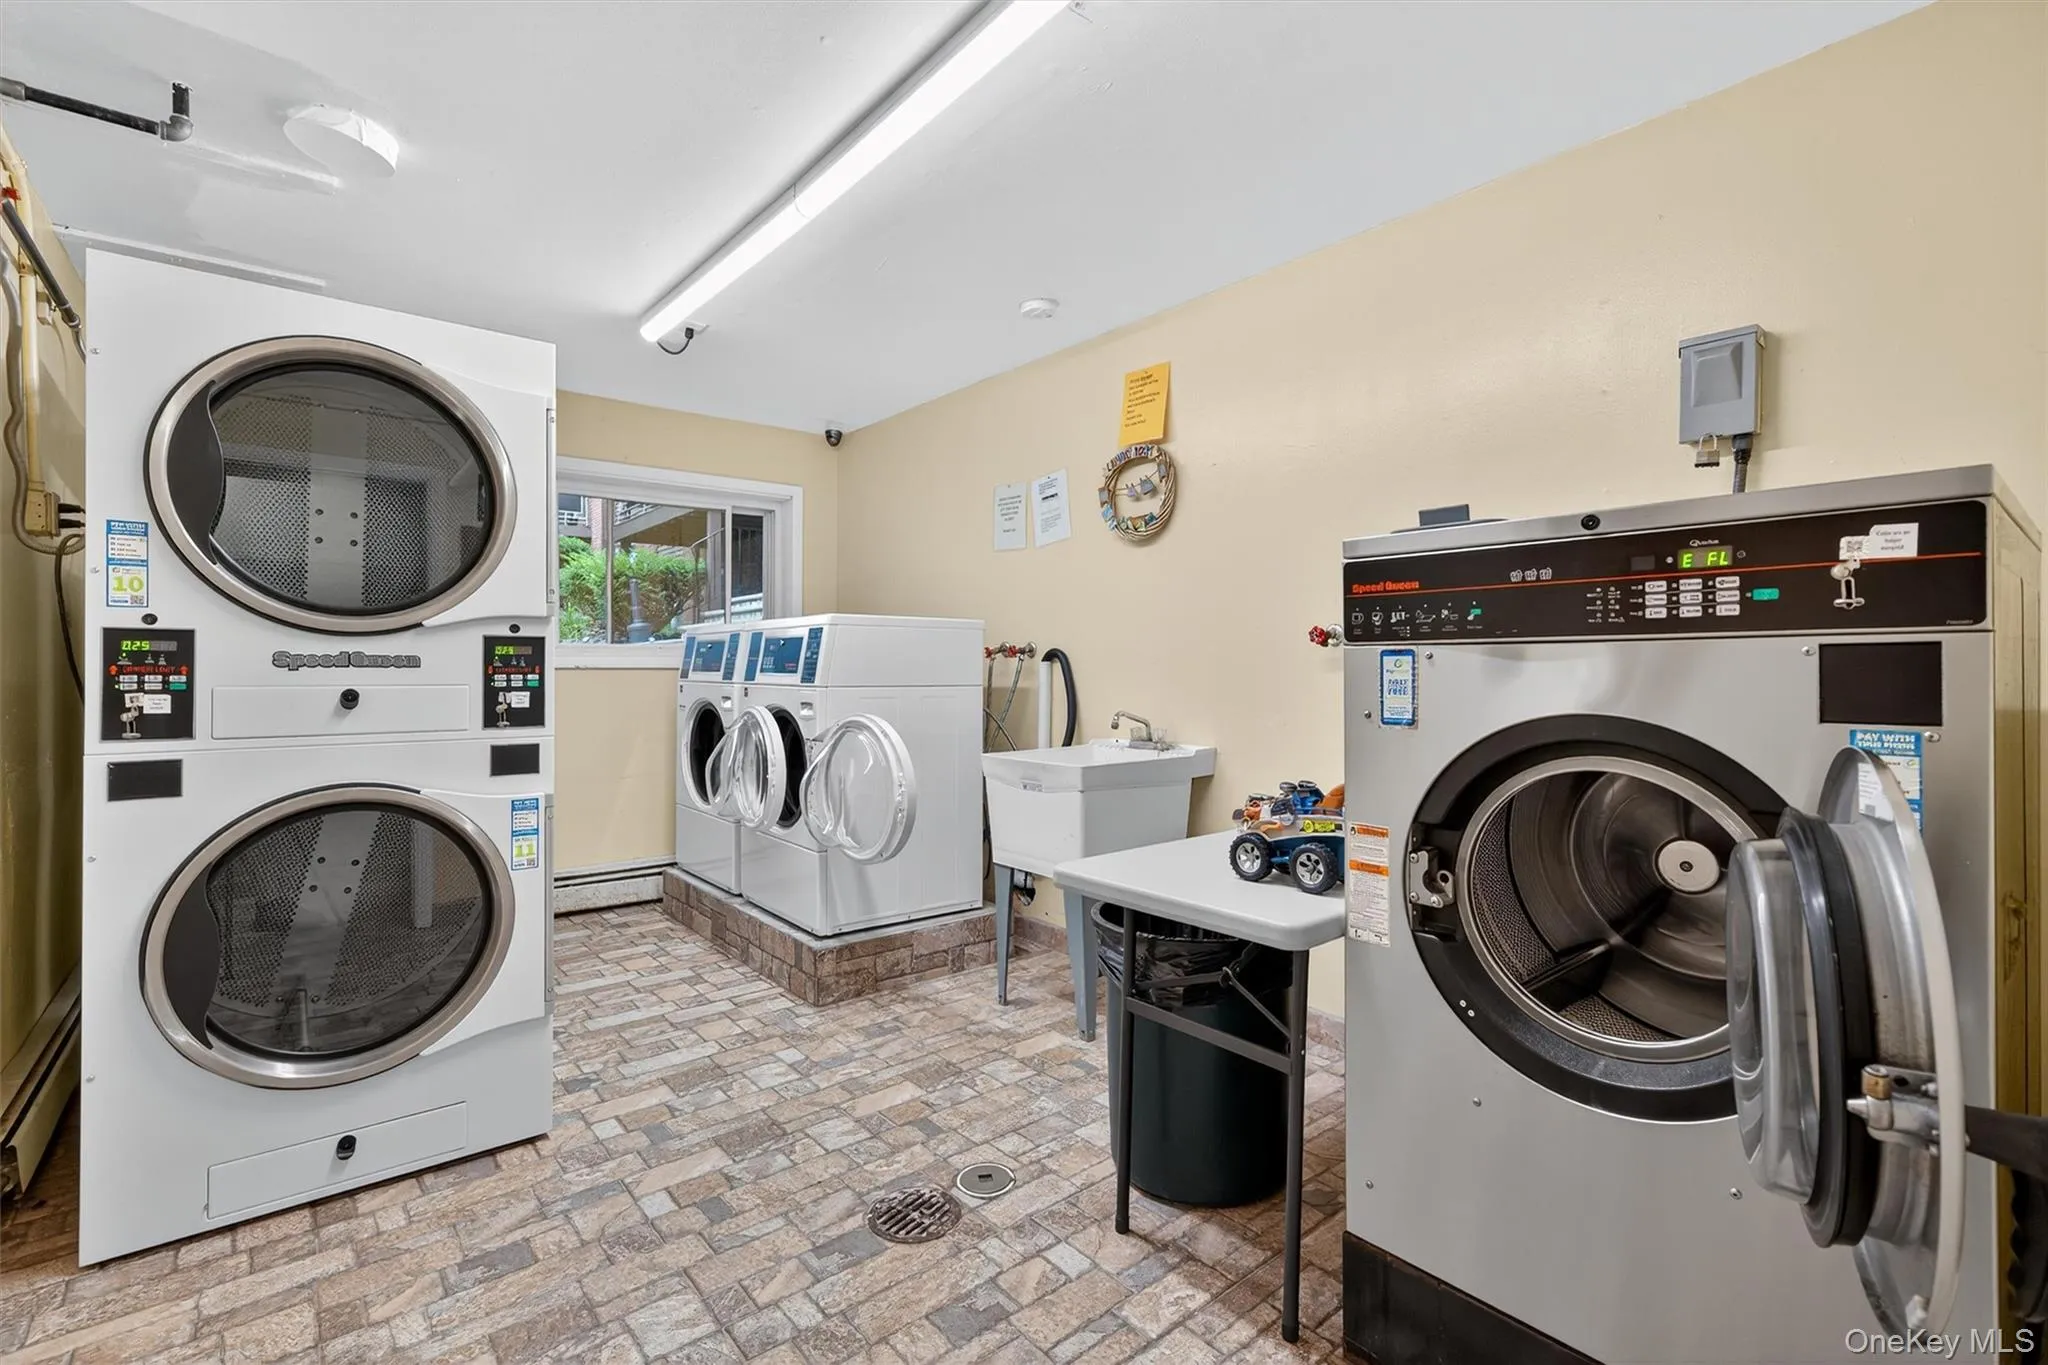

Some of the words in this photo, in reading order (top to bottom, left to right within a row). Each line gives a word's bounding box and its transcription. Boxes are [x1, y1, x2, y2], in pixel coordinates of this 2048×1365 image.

[1682, 553, 1693, 568] E
[1707, 551, 1729, 566] FL
[112, 575, 145, 593] 10
[1351, 582, 1385, 594] Speed
[1385, 580, 1420, 591] Queen
[272, 650, 350, 671] Speed
[350, 650, 421, 668] Queen
[1856, 732, 1880, 741] PAY
[1882, 734, 1916, 742] WITH
